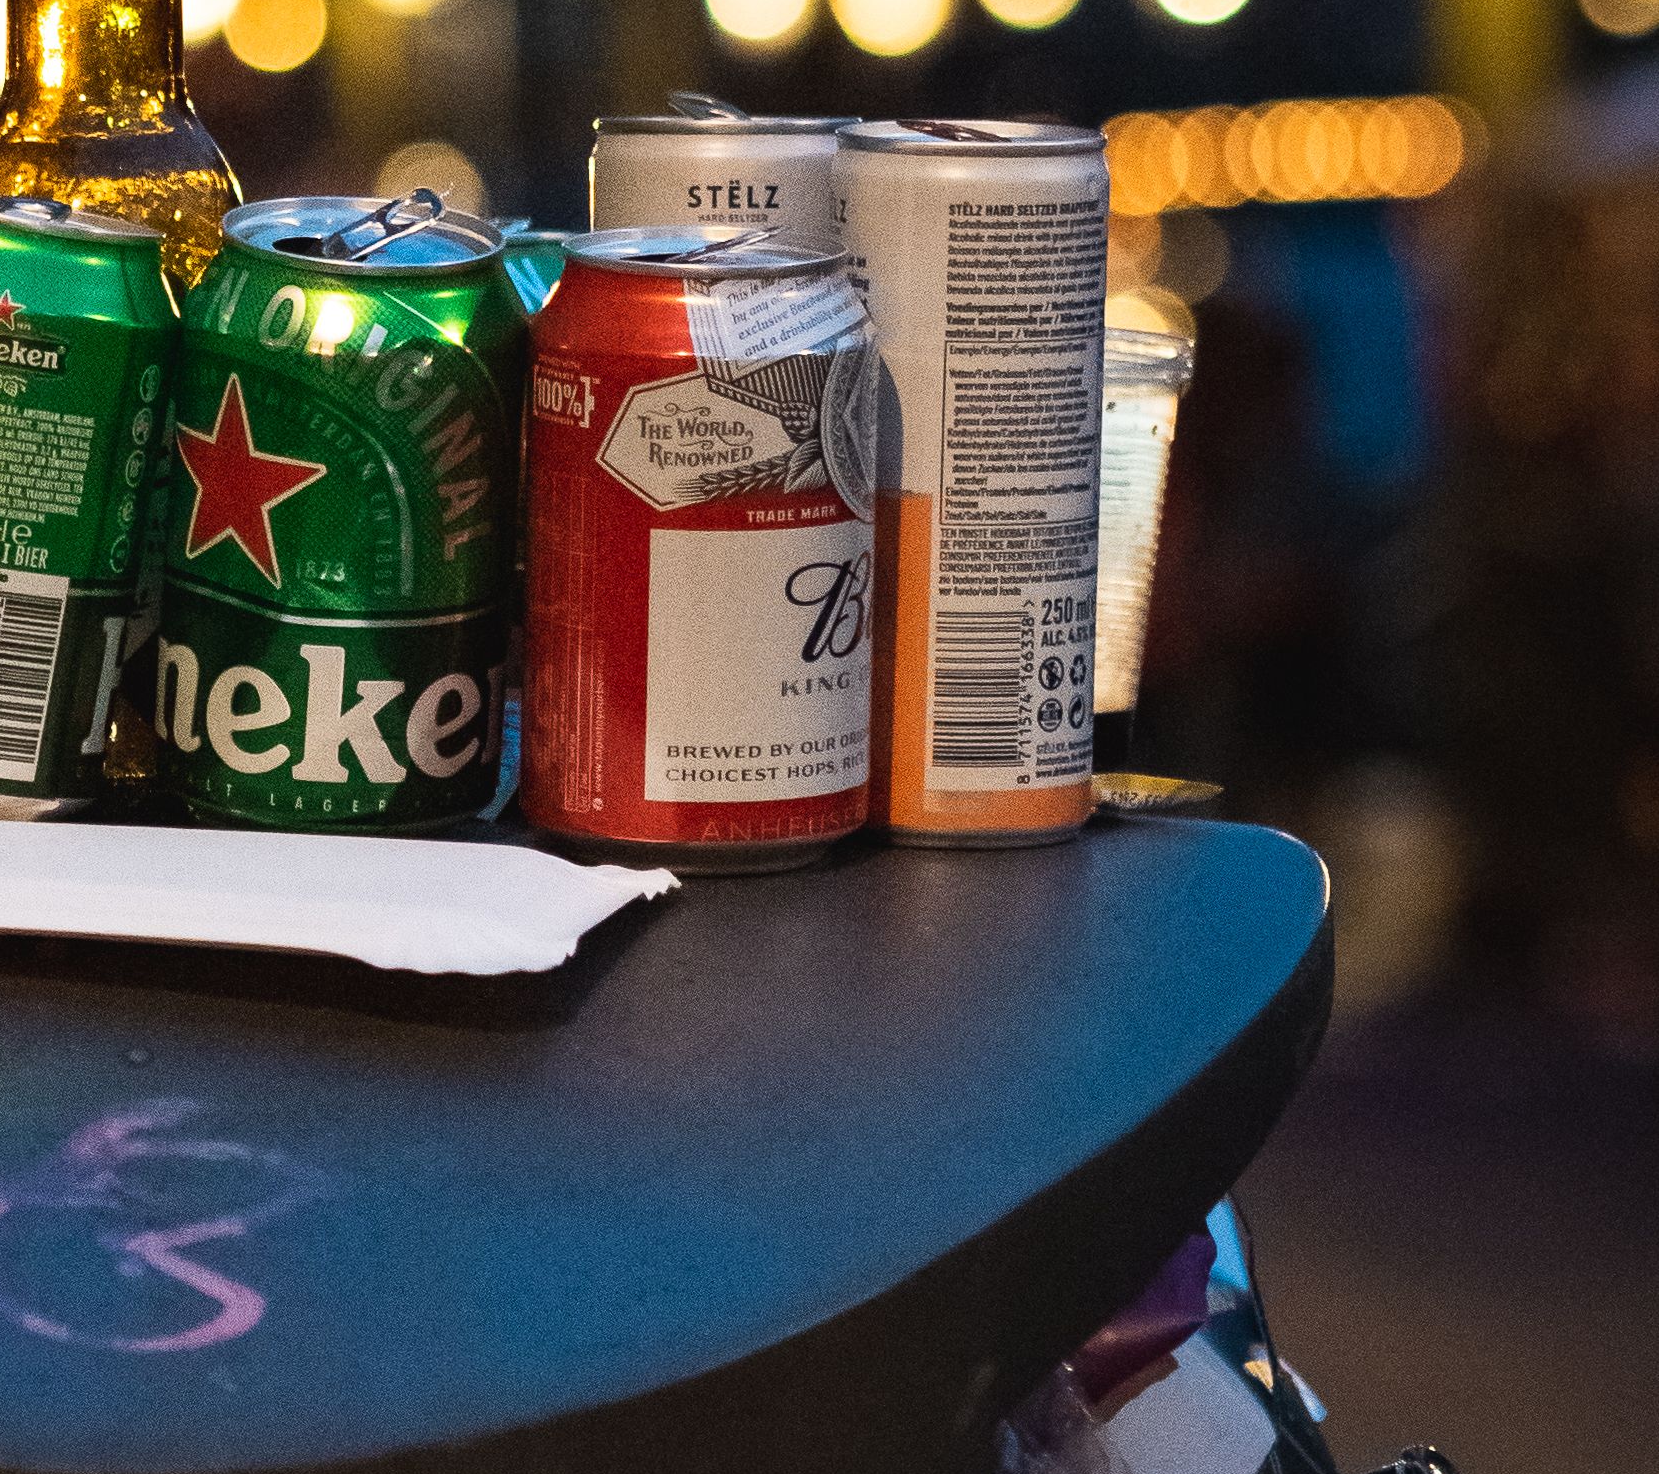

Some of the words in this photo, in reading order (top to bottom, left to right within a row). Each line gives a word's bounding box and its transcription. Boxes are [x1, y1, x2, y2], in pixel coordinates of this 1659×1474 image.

[687, 179, 780, 209] STËLZ
[949, 201, 983, 216] STËLZ
[985, 204, 1015, 216] HARD
[1017, 204, 1058, 216] SELTZER
[738, 309, 790, 340] exclusive
[744, 338, 769, 357] and
[649, 442, 755, 470] RENOWNED
[746, 509, 796, 524] TRADE
[800, 505, 838, 521] MARK
[14, 547, 49, 570] BIER
[1041, 596, 1074, 625] 250
[1041, 629, 1067, 648] ALC.
[780, 671, 852, 698] KING
[666, 744, 763, 760] BREWED
[769, 743, 796, 758] BY
[800, 739, 837, 756] OUR
[664, 766, 781, 783] CHOICEST
[786, 760, 840, 780] HOPS,
